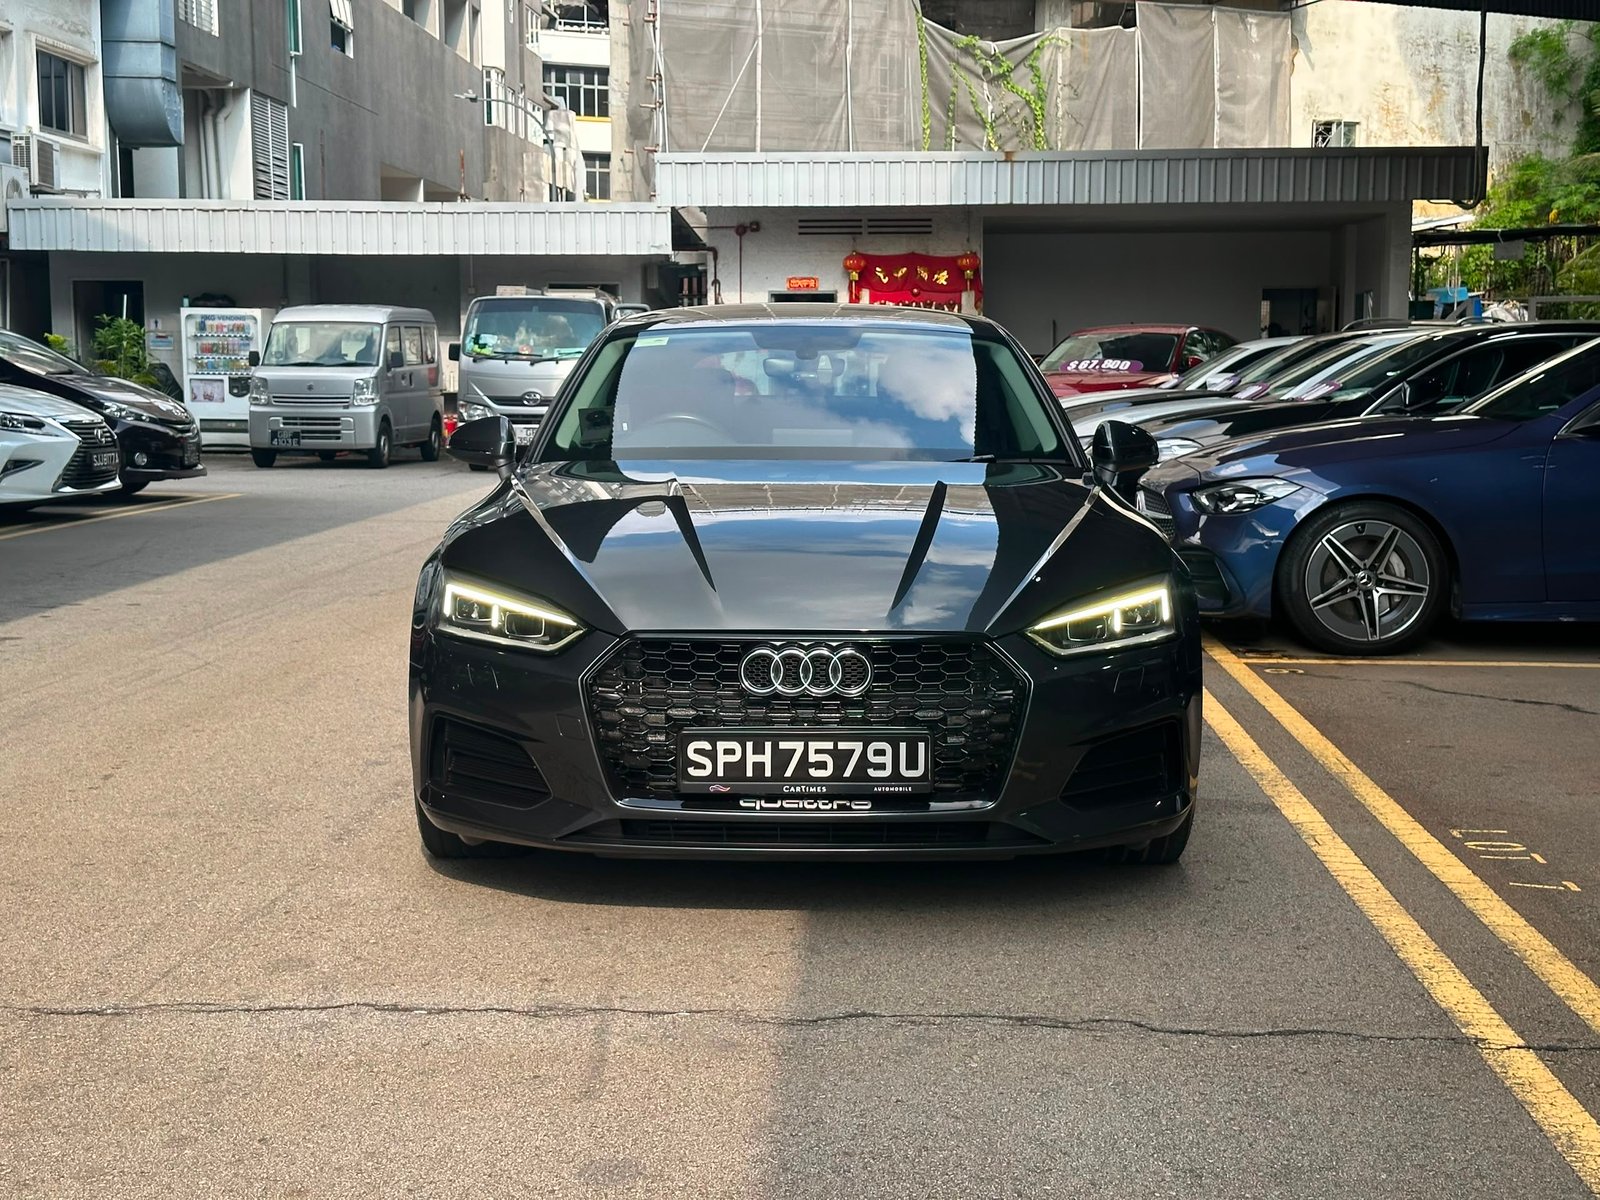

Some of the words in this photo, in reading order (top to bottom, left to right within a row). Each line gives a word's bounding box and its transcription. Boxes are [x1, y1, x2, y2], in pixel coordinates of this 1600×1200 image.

[93, 451, 119, 467] SJJ8177A
[686, 740, 926, 778] SPH7579U
[1448, 828, 1548, 864] LOT
